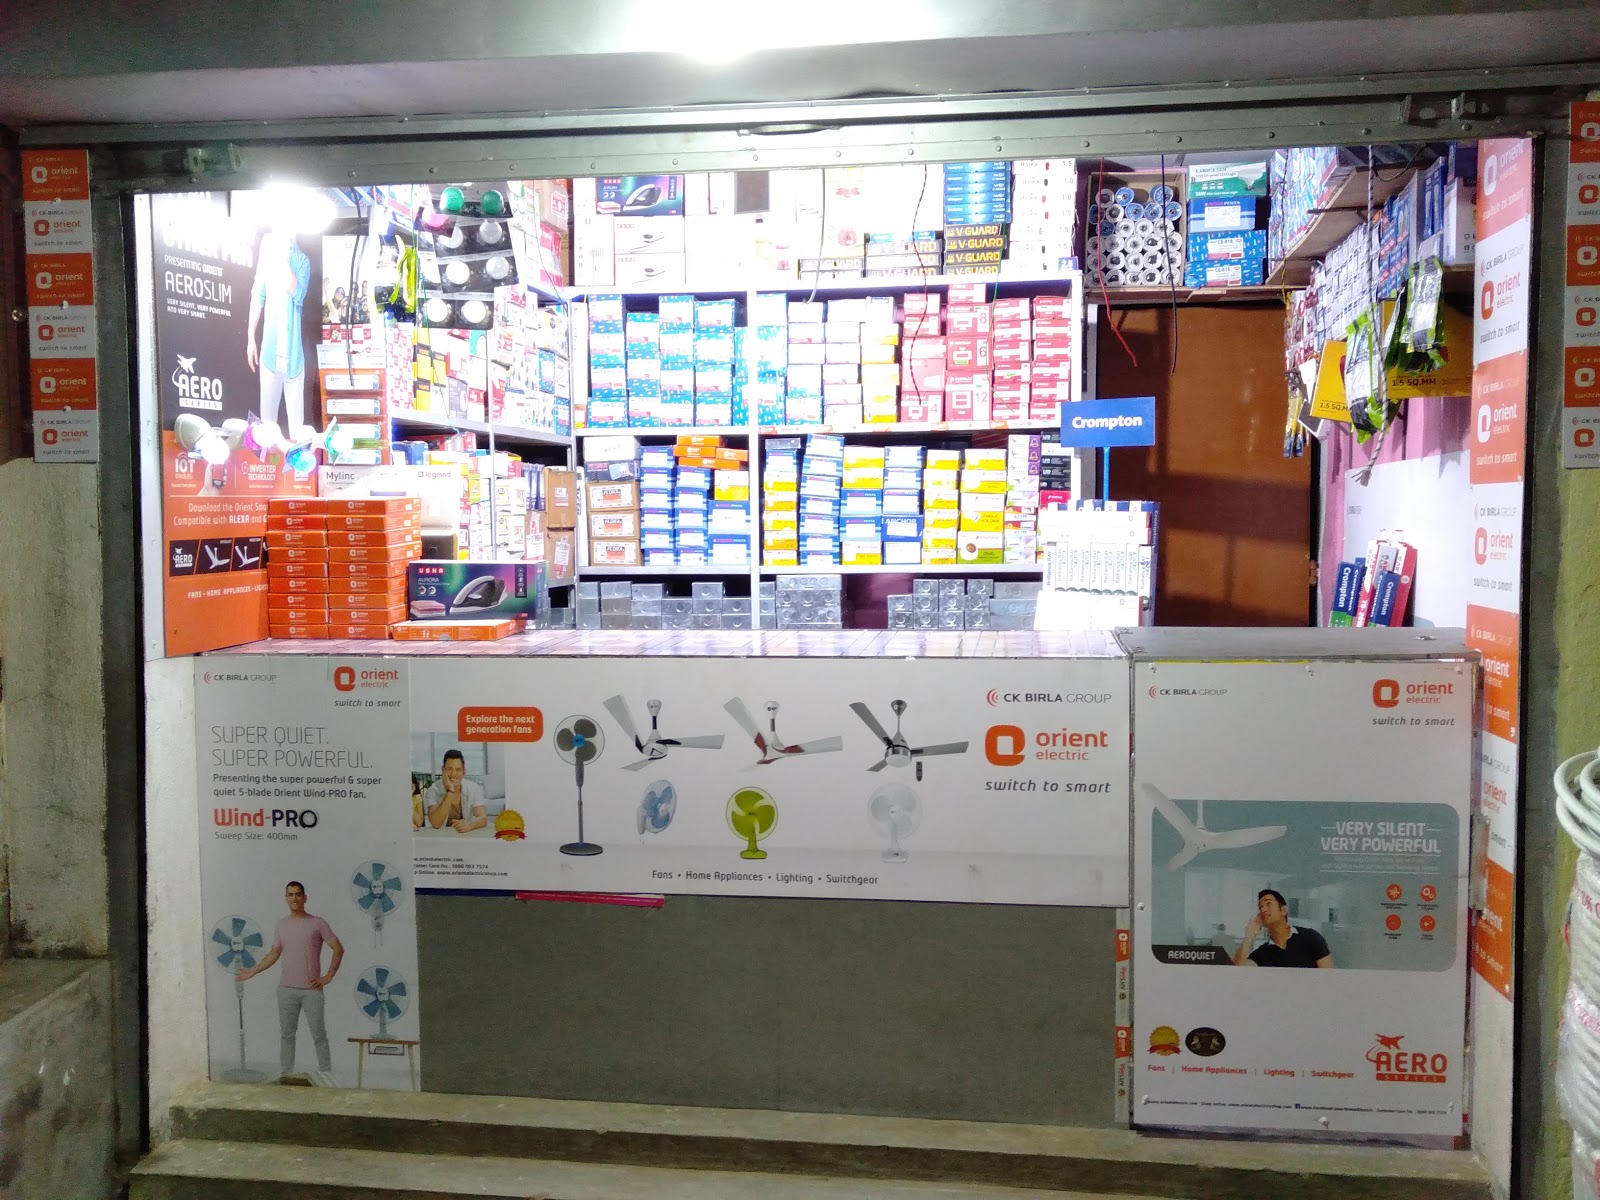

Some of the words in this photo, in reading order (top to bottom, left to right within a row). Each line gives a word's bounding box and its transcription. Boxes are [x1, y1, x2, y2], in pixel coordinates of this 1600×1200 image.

[1500, 140, 1524, 166] orient
[51, 167, 78, 175] orient
[1482, 202, 1500, 221] switch
[1509, 188, 1524, 206] smart
[53, 220, 81, 228] orient
[956, 225, 999, 236] V-GUARD
[958, 238, 1003, 249] V-GUARD
[956, 252, 1000, 263] V-GUARD
[1486, 260, 1493, 271] CK
[1493, 255, 1507, 268] BIRLA
[164, 254, 202, 272] PRESENTING
[202, 264, 223, 277] ORIENT
[55, 273, 84, 281] orient
[165, 271, 232, 304] AEROSLIM
[1496, 272, 1521, 296] orient
[1496, 294, 1514, 309] electric
[178, 307, 190, 315] VERY
[190, 310, 206, 319] SMART.
[197, 303, 209, 312] VERY
[209, 306, 231, 317] POWERFUL
[979, 312, 987, 324] 8
[57, 325, 85, 333] orient
[1480, 329, 1497, 344] switch
[1498, 326, 1503, 336] to
[1504, 320, 1520, 336] smart
[979, 346, 986, 358] 6
[60, 377, 87, 385] orient
[178, 374, 222, 400] AERO
[1407, 378, 1436, 386] SQ.MM
[1483, 385, 1489, 394] CK
[1490, 381, 1503, 393] BIRLA
[975, 392, 988, 403] 12
[930, 403, 938, 413] 4
[1493, 403, 1518, 422] orient
[1072, 415, 1142, 430] Crompton
[1493, 424, 1511, 435] electric
[1476, 455, 1494, 466] switch
[1494, 455, 1500, 464] to
[1501, 452, 1517, 463] smart
[175, 458, 196, 473] IOT
[250, 464, 276, 474] INVERTER
[248, 473, 276, 481] TECHNOLOGY
[326, 471, 355, 481] Mylinc
[425, 471, 451, 479] legrand
[188, 503, 222, 513] Download
[222, 503, 233, 512] the
[235, 502, 254, 512] Orient
[1480, 508, 1486, 516] CK
[1486, 507, 1500, 517] BIRLA
[1500, 506, 1517, 517] GROUP
[174, 515, 211, 527] Compatible
[213, 515, 228, 524] with
[229, 515, 249, 524] ALEXA
[251, 515, 262, 523] and
[1490, 531, 1513, 549] orient
[174, 554, 193, 563] AERO
[1490, 551, 1507, 560] electric
[1338, 567, 1351, 607] Crompton
[1348, 569, 1358, 611] Crompton
[1473, 577, 1490, 588] switch
[1491, 580, 1497, 589] to
[1497, 580, 1513, 592] smart
[207, 589, 221, 597] HOME
[223, 586, 251, 595] APPLIANCES
[1381, 582, 1394, 615] Crompton
[1476, 630, 1482, 640] CK
[1483, 631, 1496, 643] BIRLA
[360, 667, 399, 680] orient
[1485, 657, 1510, 678] orient
[250, 674, 277, 682] GROUP
[1406, 681, 1454, 695] orient
[334, 699, 361, 707] switch
[377, 699, 401, 708] smart
[1003, 693, 1021, 703] CK
[1025, 693, 1063, 703] BIRLA
[1066, 693, 1112, 703] GROUP
[1406, 696, 1441, 704] electric
[465, 715, 497, 725] Explore
[500, 715, 513, 724] the
[515, 715, 535, 724] next
[1493, 706, 1510, 721] smart
[1372, 717, 1406, 726] switch
[1410, 717, 1421, 726] to
[1425, 717, 1455, 726] smart
[211, 726, 268, 744] SUPER
[274, 727, 329, 747] QUIET.
[465, 725, 511, 735] generation
[513, 725, 532, 733] fans
[1036, 728, 1108, 748] orient
[212, 749, 268, 767] SUPER
[275, 750, 373, 769] POWERFUL.
[1036, 750, 1089, 761] electric
[213, 773, 260, 784] Presenting
[262, 774, 277, 783] the
[280, 777, 304, 786] super
[306, 776, 346, 785] powerful
[357, 777, 381, 786] super
[985, 779, 1036, 792] switch
[1043, 780, 1058, 792] to
[1066, 781, 1111, 793] smart
[213, 788, 235, 798] quiet
[239, 788, 272, 797] 5-blade
[274, 789, 300, 797] Orient
[303, 789, 347, 798] Wind-PRO
[349, 790, 367, 799] fan.
[1484, 779, 1507, 805] orient
[214, 808, 319, 829] Wind-PRO
[1336, 822, 1373, 836] VERY
[1377, 822, 1426, 837] SILENT
[215, 832, 242, 841] Sweep
[246, 832, 264, 840] Size:
[267, 832, 298, 841] 400mm
[1321, 837, 1358, 851] VERY
[1362, 838, 1441, 854] POWERFUL
[652, 870, 673, 880] Fans
[686, 871, 711, 881] Home
[714, 871, 763, 882] Appliances
[776, 872, 813, 884] Lighting
[826, 873, 878, 885] Switchgear
[1168, 950, 1216, 960] AEROQUIET
[1375, 1052, 1447, 1073] AERO
[1205, 1066, 1247, 1074] Appliances
[1264, 1069, 1295, 1077] Lighting
[1311, 1070, 1355, 1079] Switchgear
